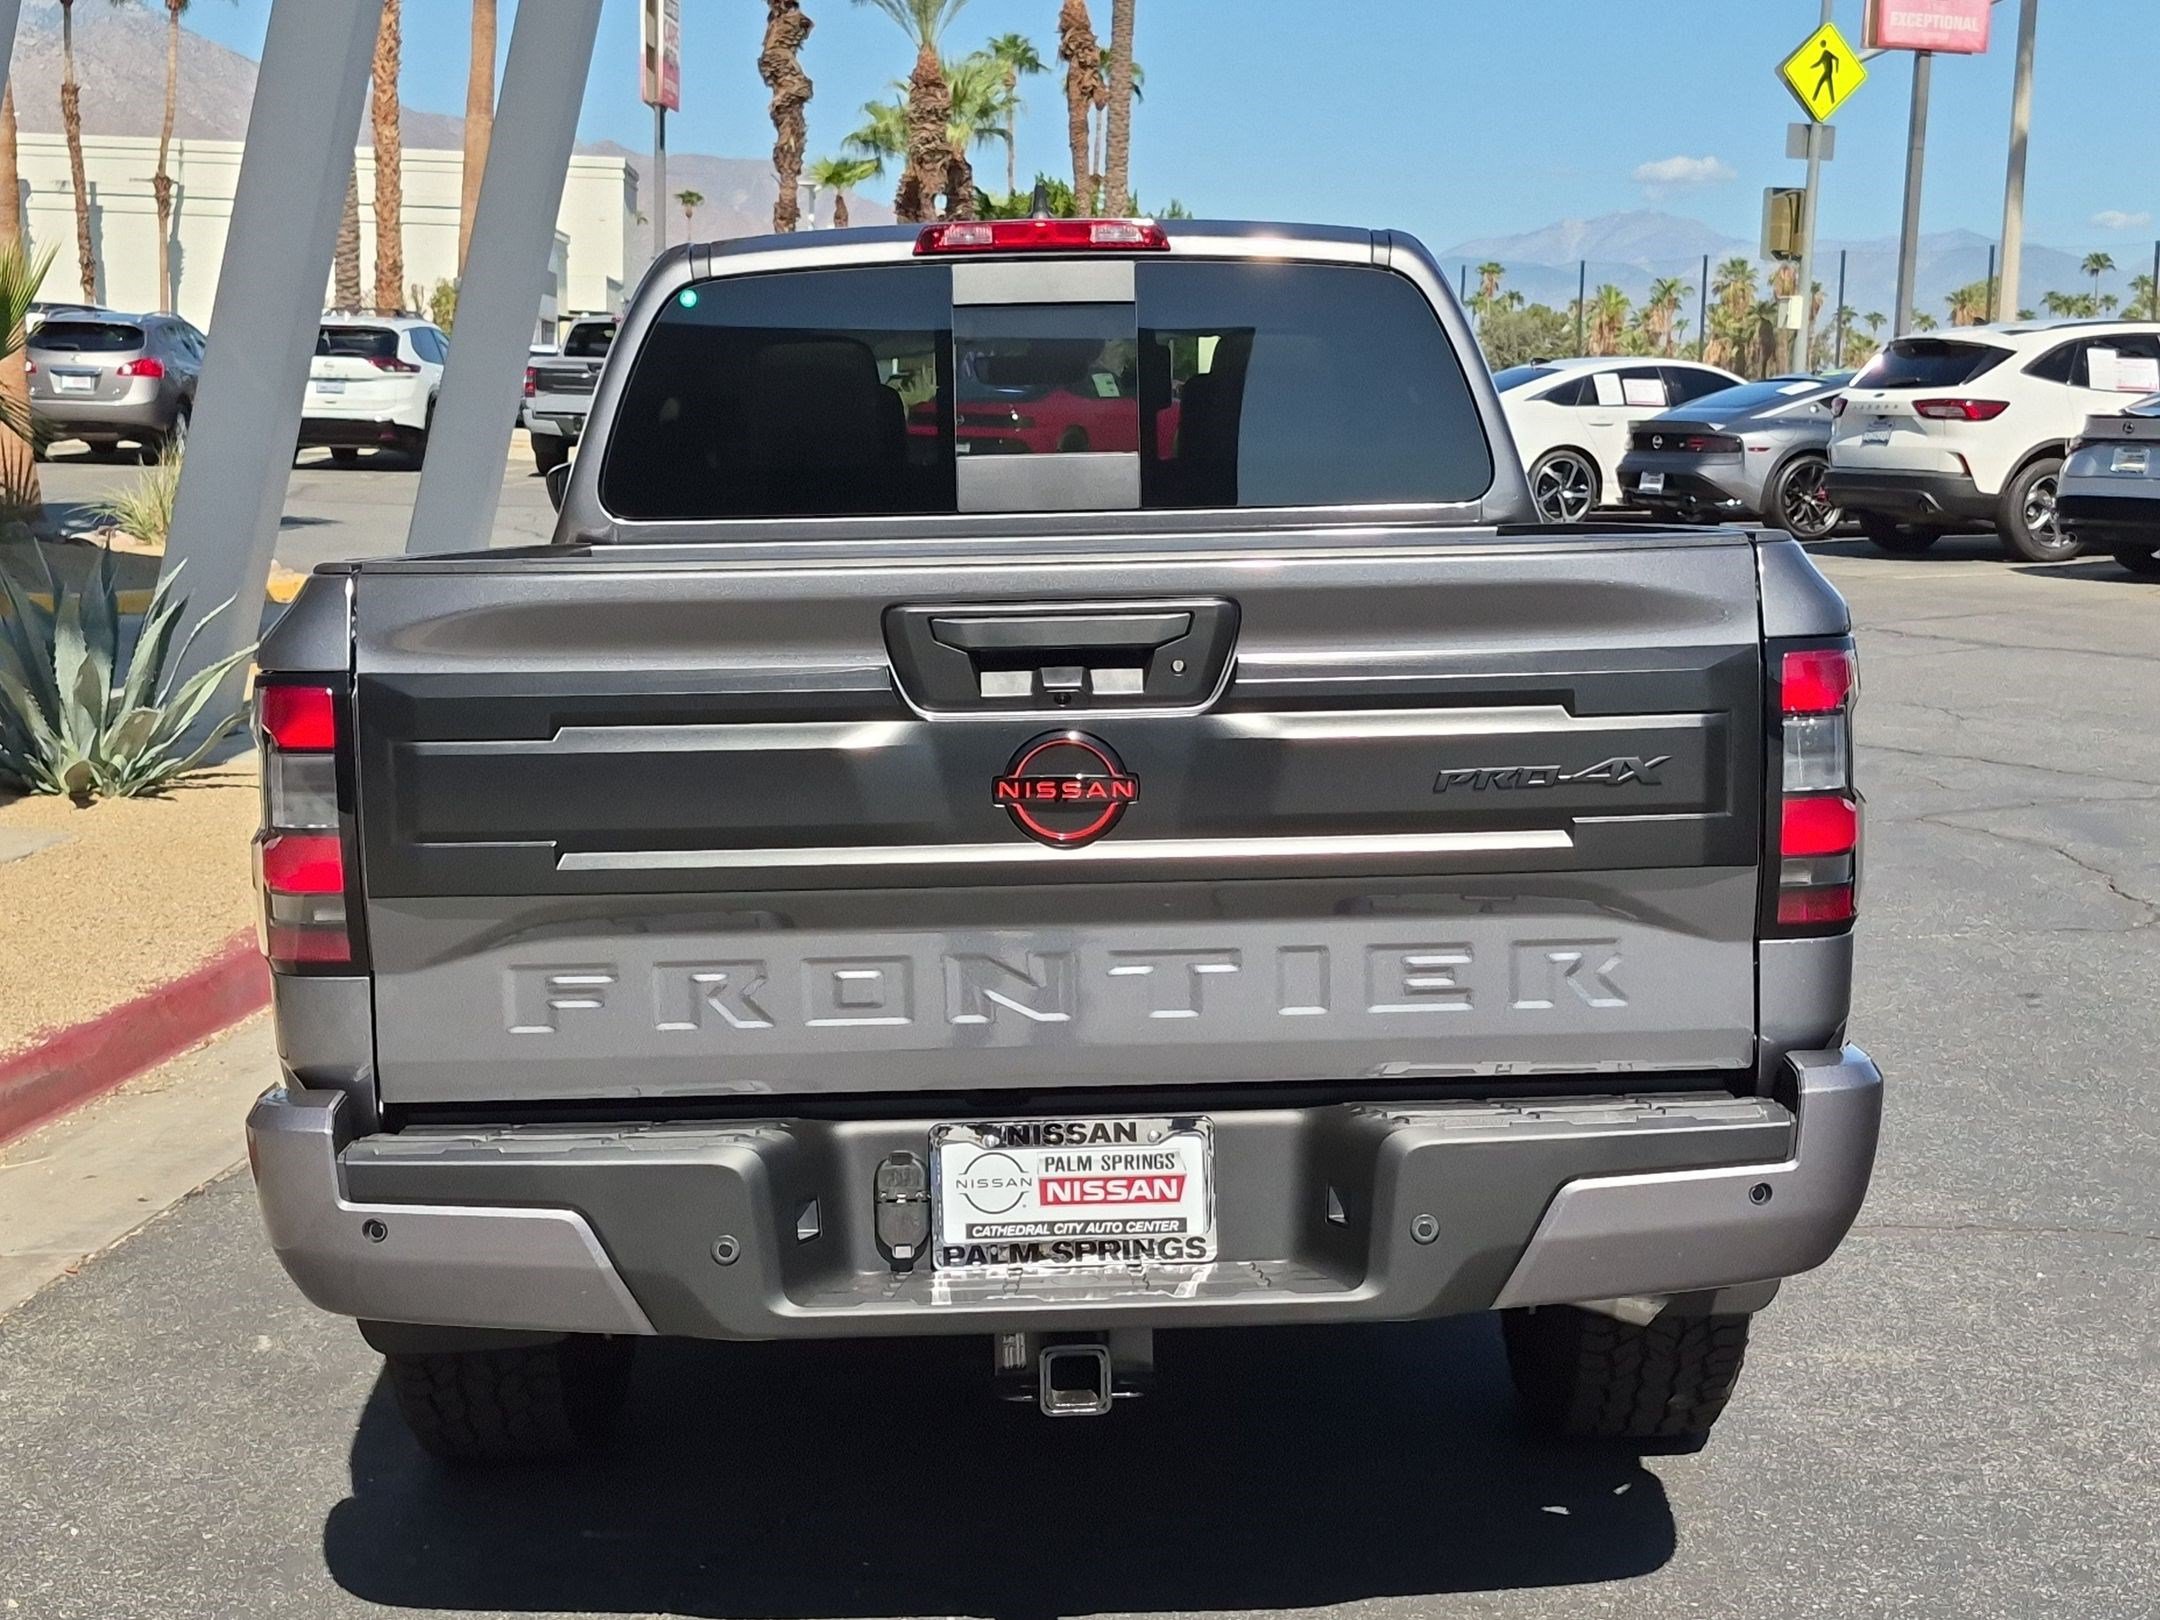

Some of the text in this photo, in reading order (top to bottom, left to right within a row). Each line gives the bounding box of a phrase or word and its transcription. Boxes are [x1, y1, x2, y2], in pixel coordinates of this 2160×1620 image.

[1890, 12, 1980, 32] EXCEPTIONAL
[999, 781, 1134, 799] NISSAN
[507, 937, 1629, 1034] FRONTIER
[1006, 1122, 1137, 1145] NISSAN
[1044, 1152, 1175, 1173] PALM SPRINGS
[956, 1177, 1032, 1189] NISSAN
[1046, 1179, 1178, 1202] NISSAN
[972, 1219, 1179, 1238] CATHEDRAL CITY AUTO CENTER
[943, 1236, 1207, 1267] PALM SPRINGS
